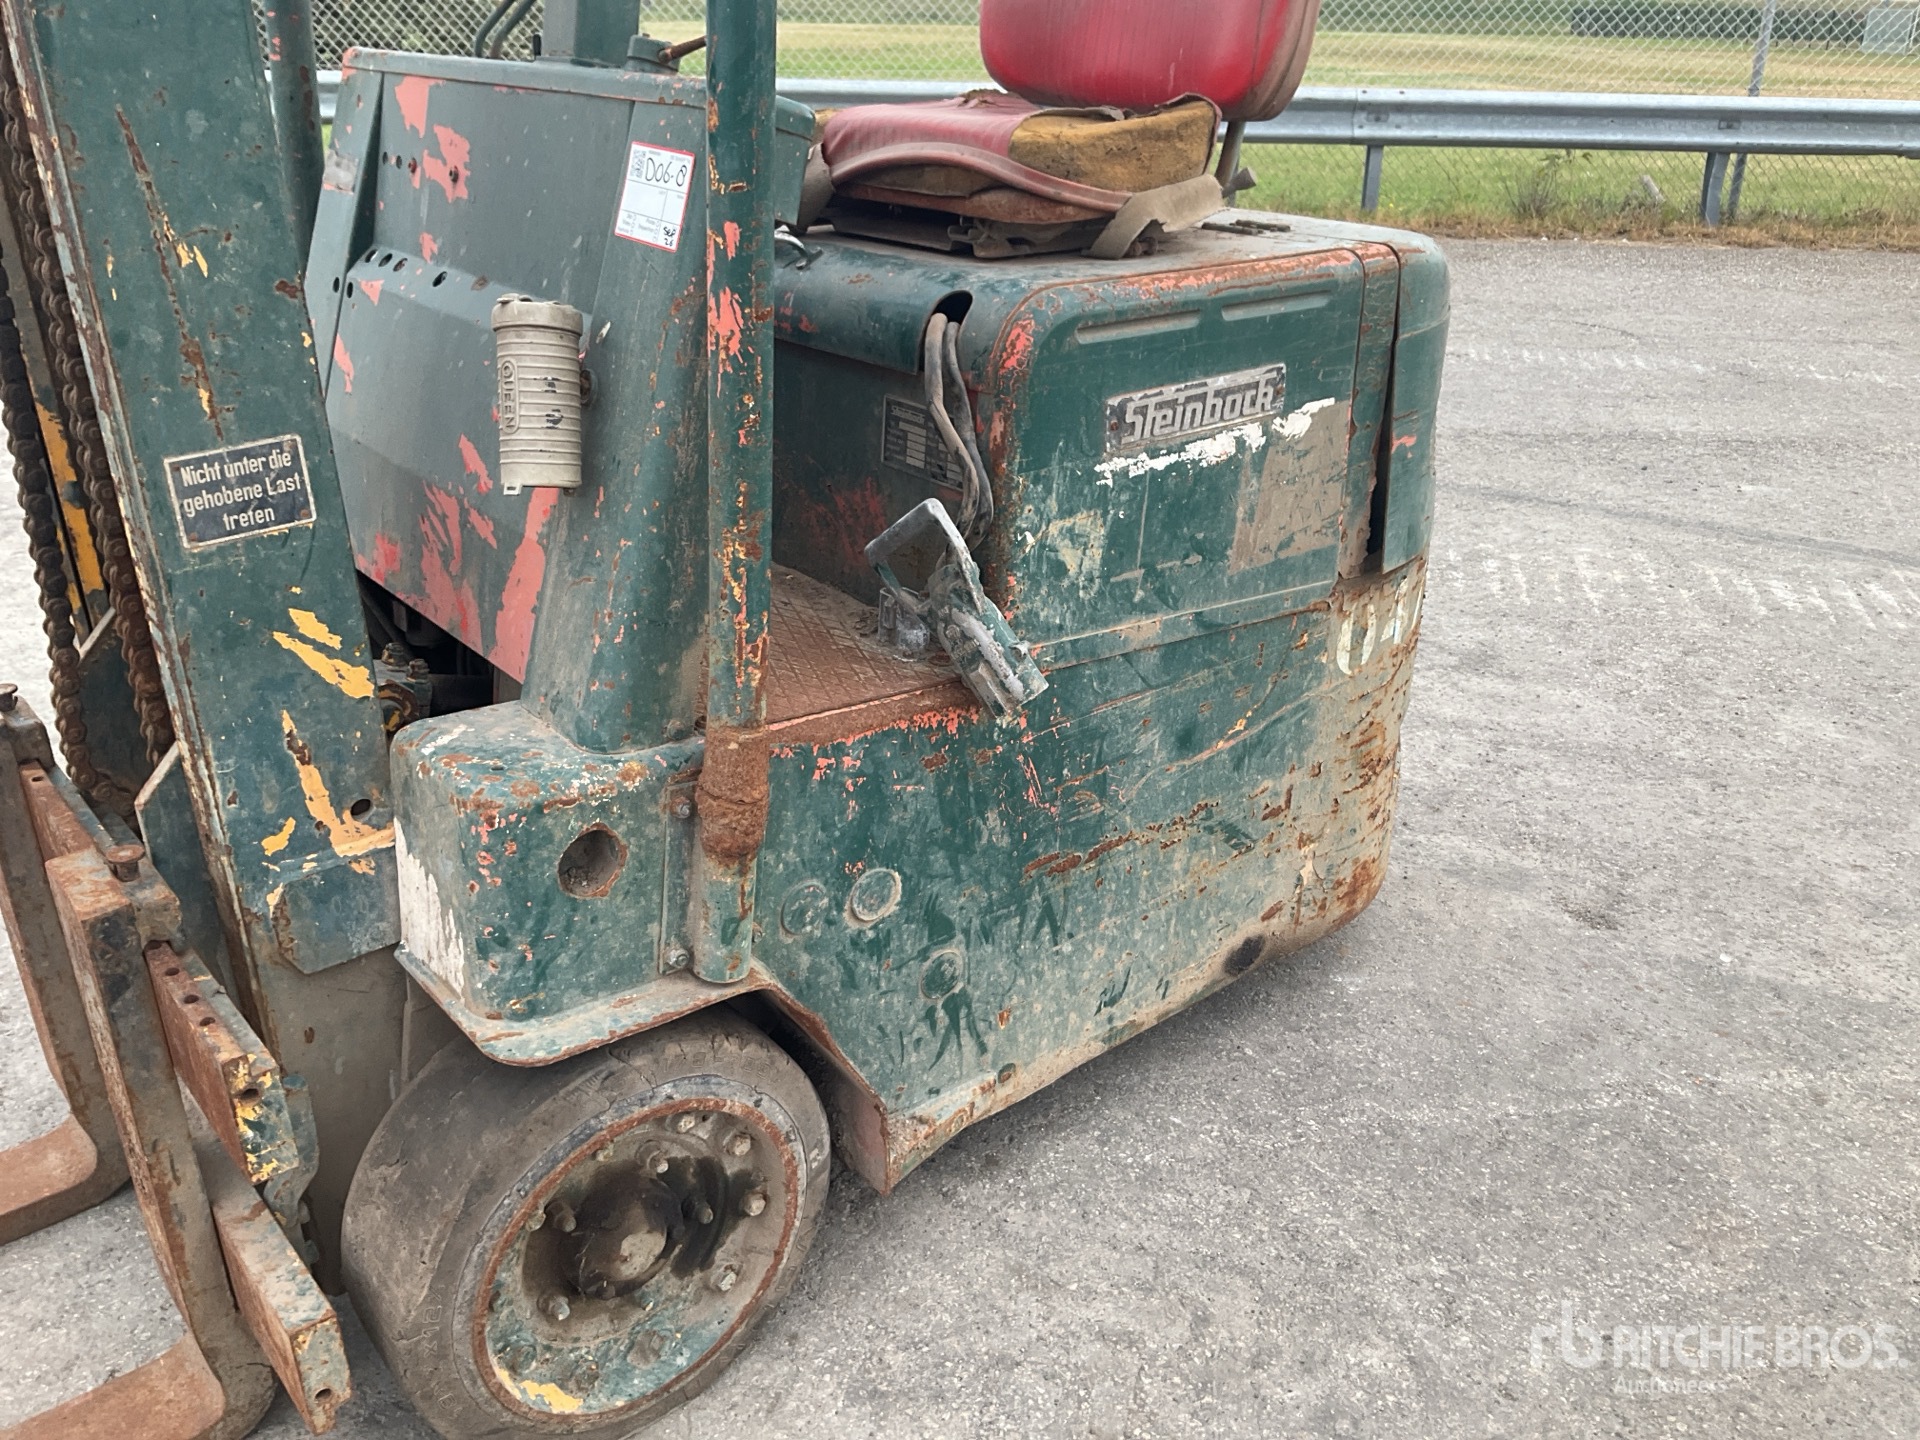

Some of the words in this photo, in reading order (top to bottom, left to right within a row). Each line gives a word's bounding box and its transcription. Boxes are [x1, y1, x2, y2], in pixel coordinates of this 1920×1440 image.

[1121, 370, 1278, 445] Steinbock
[180, 461, 222, 487] Nicht
[224, 456, 266, 478] unter
[269, 449, 292, 470] die
[182, 482, 264, 518] gehobene
[265, 471, 302, 496] Last
[222, 507, 276, 531] treten
